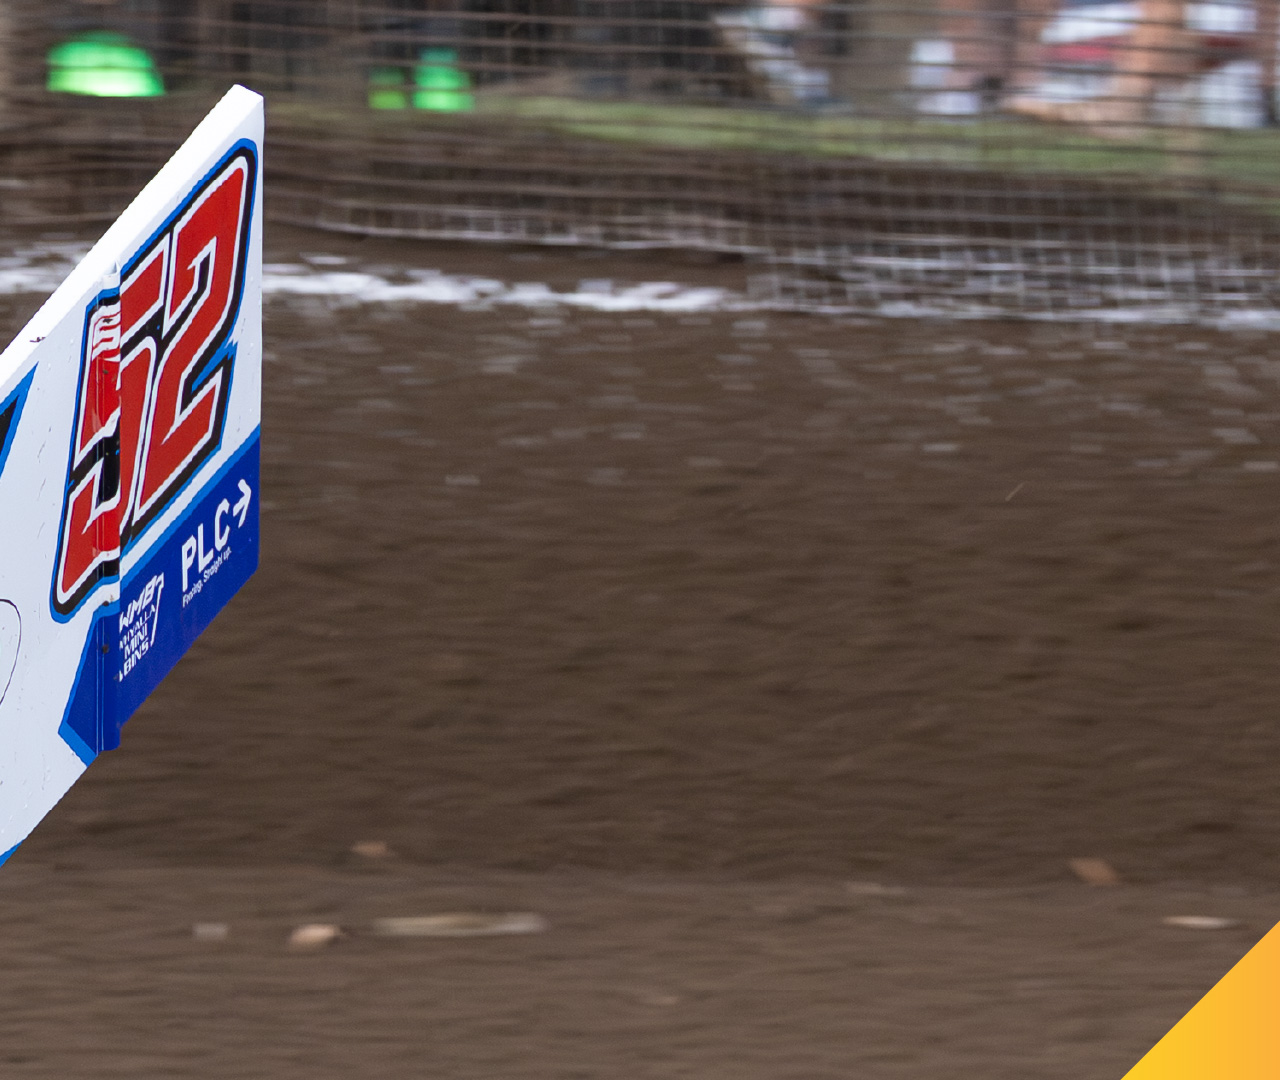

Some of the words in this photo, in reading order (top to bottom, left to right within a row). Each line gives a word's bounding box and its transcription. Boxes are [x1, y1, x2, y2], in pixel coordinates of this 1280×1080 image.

[56, 150, 250, 610] 52
[182, 498, 230, 592] PLC
[123, 638, 148, 676] BINS
[124, 623, 148, 659] MINI
